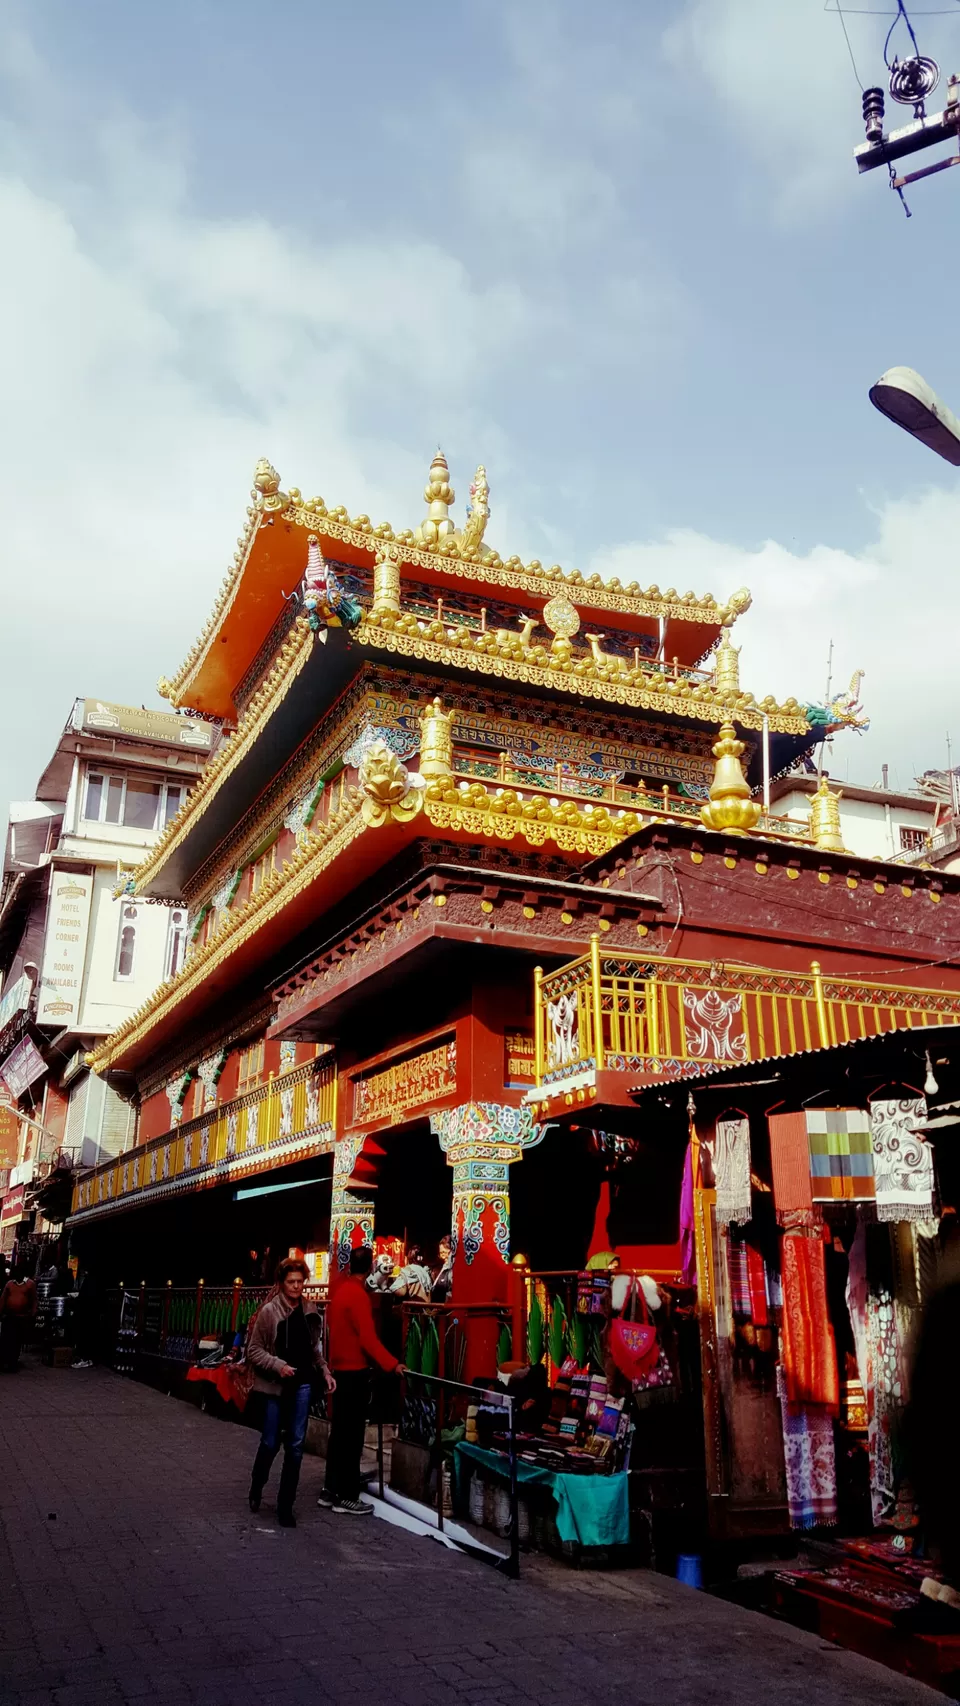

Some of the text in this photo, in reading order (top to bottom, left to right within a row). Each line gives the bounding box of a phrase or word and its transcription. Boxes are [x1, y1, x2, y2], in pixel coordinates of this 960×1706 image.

[113, 707, 133, 716] HOTEL
[134, 710, 160, 720] FRIENDS
[121, 726, 176, 741] ROOMS AVAILABLE
[61, 903, 80, 913] HOTEL
[56, 918, 81, 928] FRIENDS
[55, 933, 80, 943] CORNER
[53, 962, 75, 972] ROOMS
[45, 978, 78, 988] AVAILABLE
